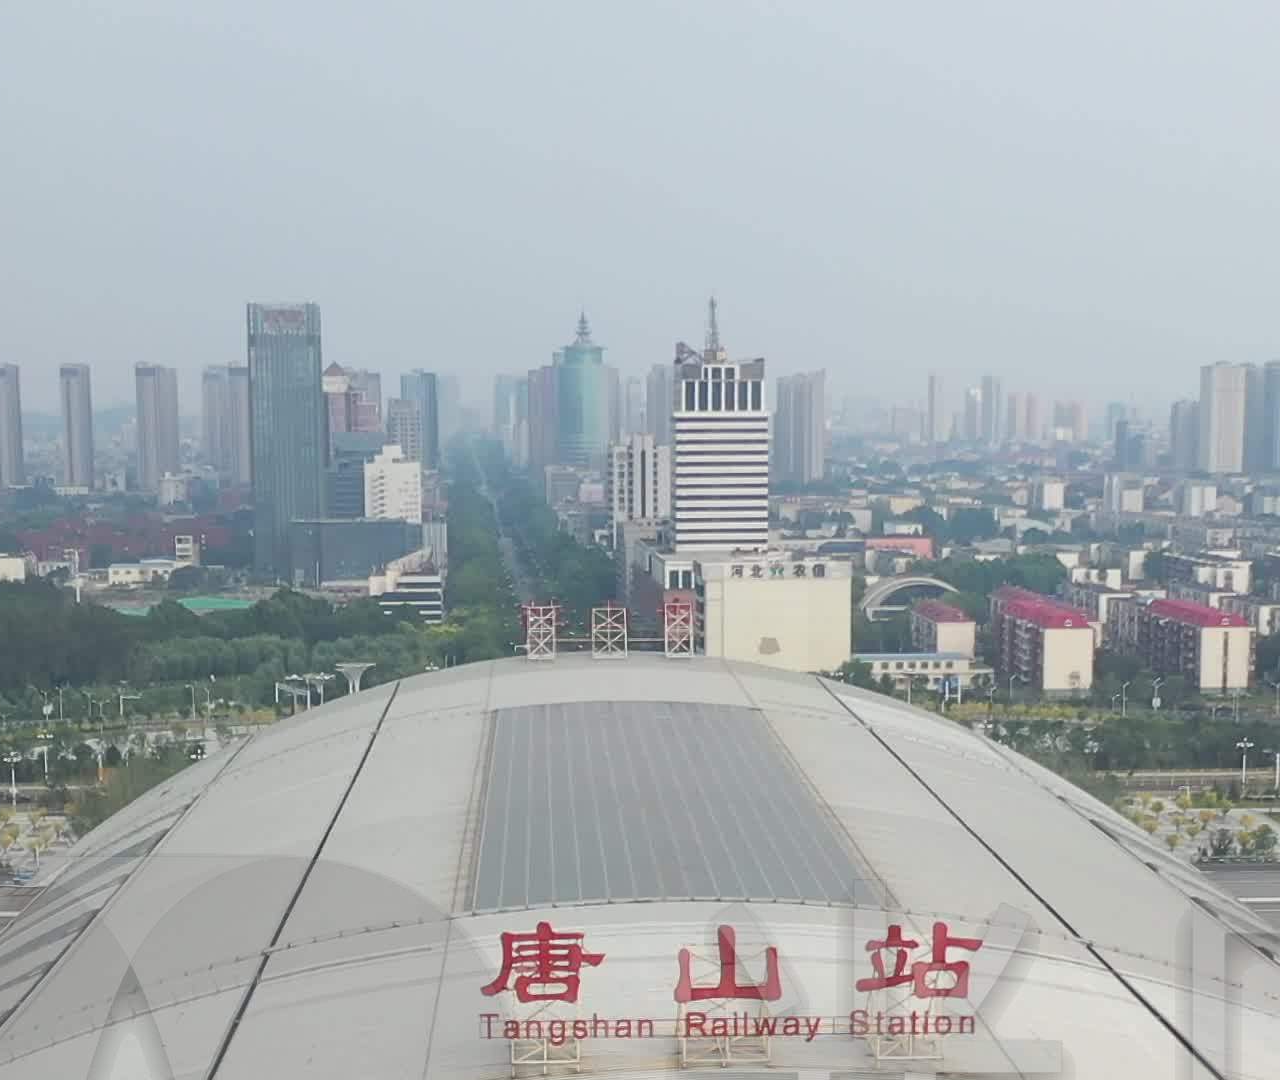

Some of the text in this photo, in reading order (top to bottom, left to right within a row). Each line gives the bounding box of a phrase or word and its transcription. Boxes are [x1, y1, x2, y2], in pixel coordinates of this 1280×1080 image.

[480, 921, 984, 1003] 唐山站
[480, 1009, 976, 1046] Tangshan Railway Station
